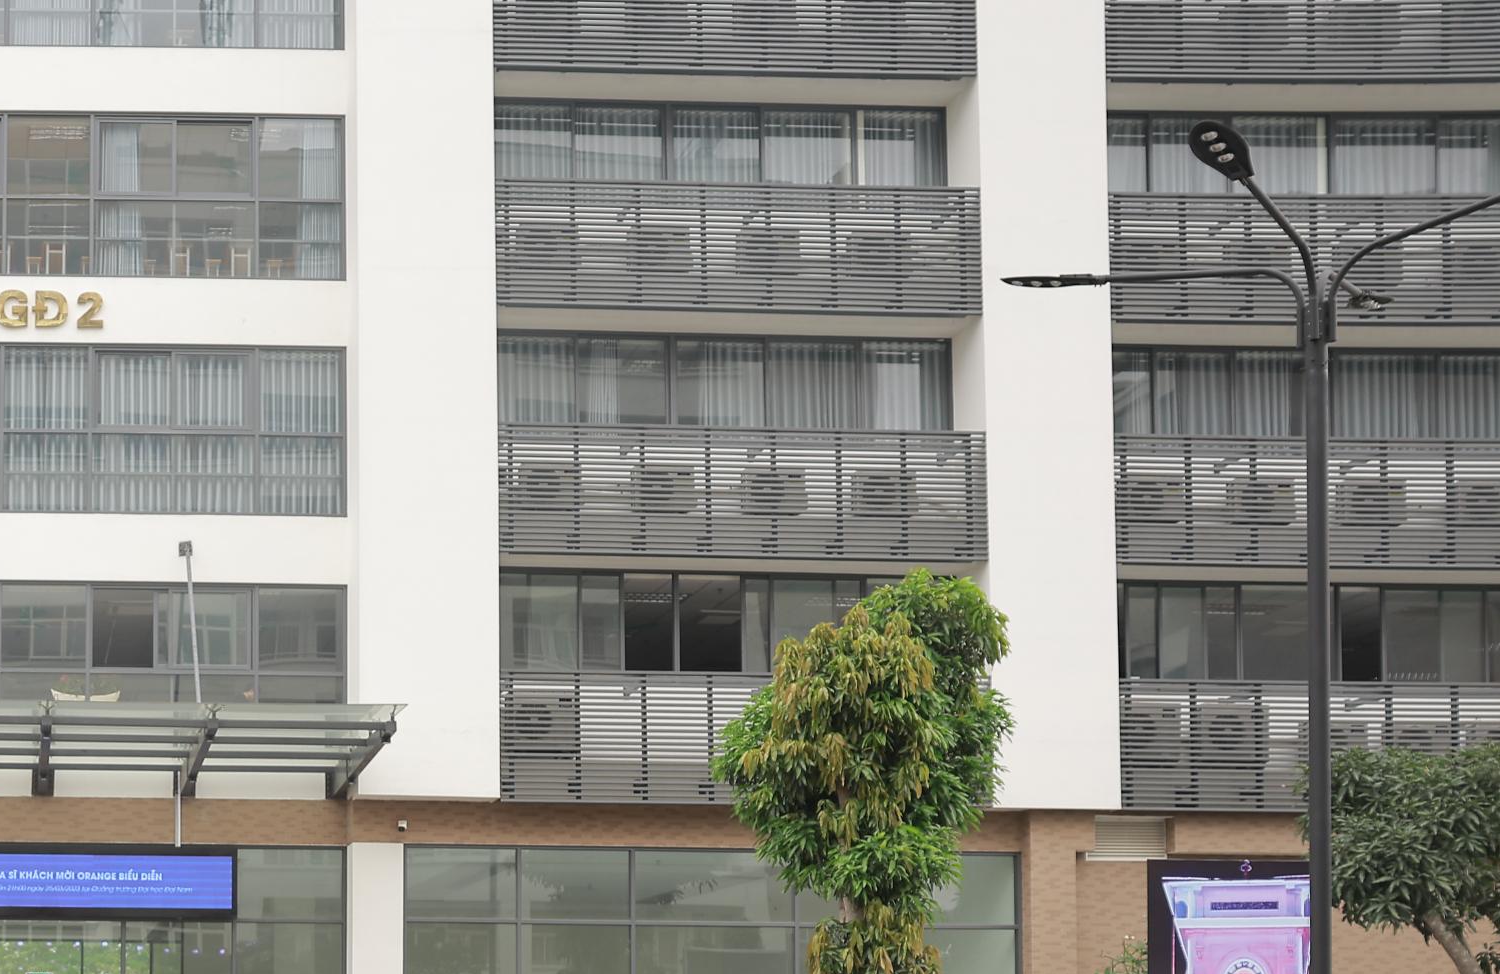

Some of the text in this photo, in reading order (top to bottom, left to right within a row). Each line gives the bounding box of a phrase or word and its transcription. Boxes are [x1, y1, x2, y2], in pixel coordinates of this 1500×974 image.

[8, 869, 18, 880] SĨ
[19, 869, 54, 880] KHÁCH
[56, 869, 75, 880] MỜI
[77, 871, 117, 881] ORANGE
[118, 868, 139, 881] BIỂU
[140, 868, 163, 881] DIỄN
